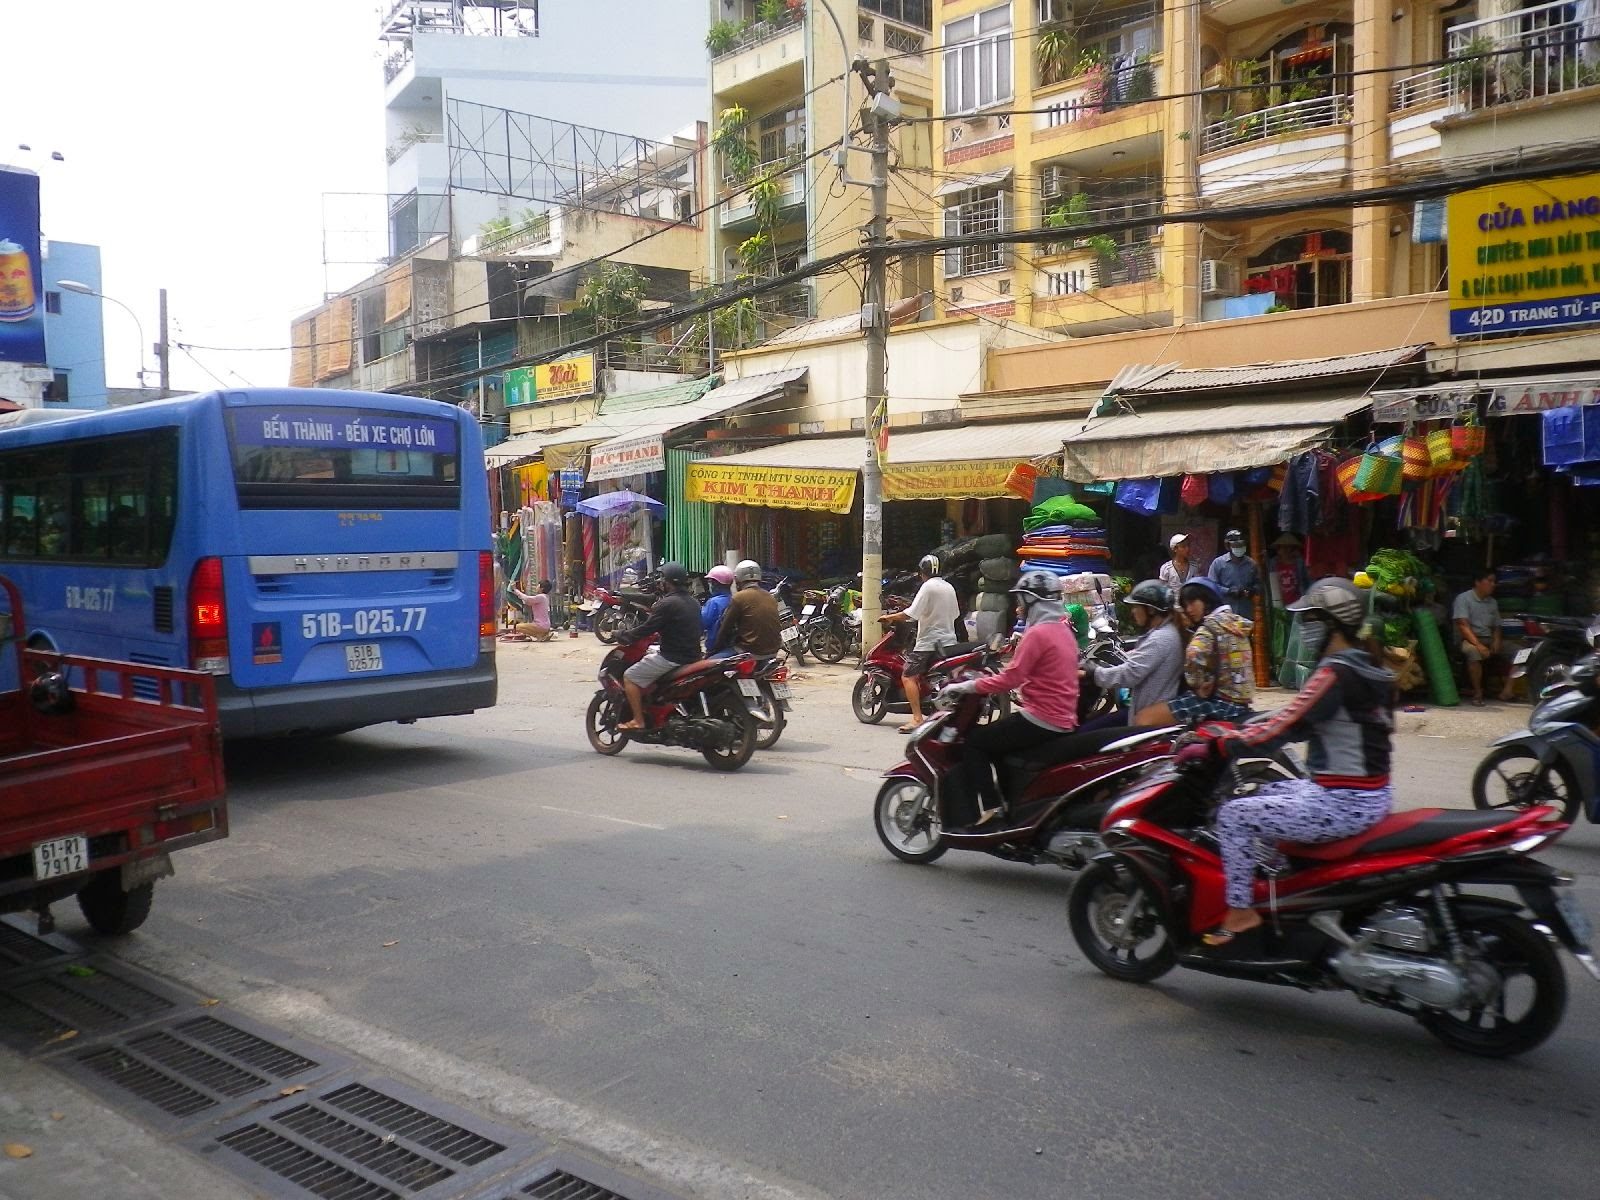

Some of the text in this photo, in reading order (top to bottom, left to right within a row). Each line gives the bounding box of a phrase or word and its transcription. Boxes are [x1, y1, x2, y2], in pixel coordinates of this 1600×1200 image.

[1477, 201, 1526, 232] CỬA
[1469, 308, 1505, 326] 42D
[1509, 305, 1559, 322] TRANG
[263, 413, 289, 439] BẾN
[292, 418, 334, 441] THÀNH
[345, 418, 369, 442] BẾN
[373, 425, 387, 444] XE
[390, 425, 412, 447] CHỢ
[415, 424, 436, 446] LỚN
[690, 468, 718, 479] CÔNG
[720, 471, 735, 480] TY
[737, 471, 767, 481] TNHH
[768, 473, 793, 483] MTV
[793, 474, 826, 486] SONG
[703, 480, 748, 497] KIM
[302, 607, 427, 639] 51B-025.77
[353, 645, 373, 658] 51B
[43, 855, 82, 877] 7912
